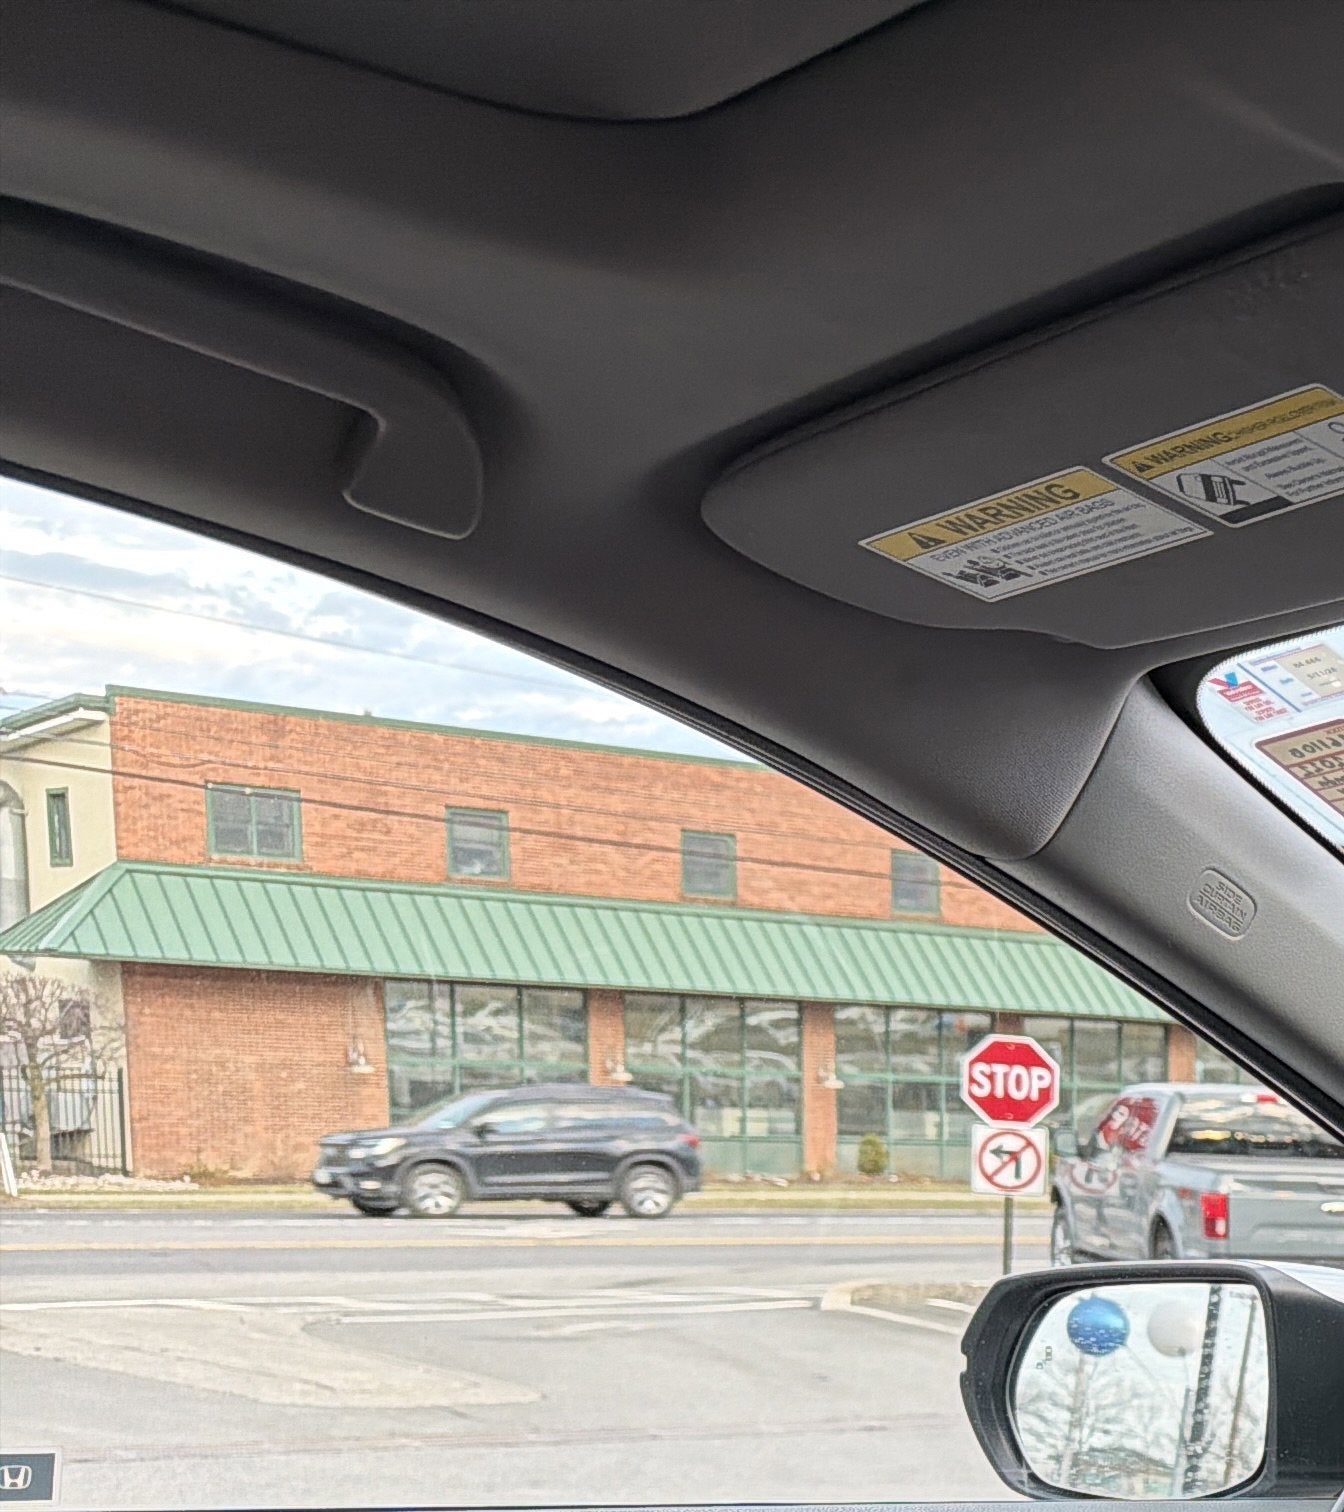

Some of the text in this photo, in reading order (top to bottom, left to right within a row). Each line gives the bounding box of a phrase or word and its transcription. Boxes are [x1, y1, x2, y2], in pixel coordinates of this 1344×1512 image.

[938, 483, 1081, 536] WARNING
[1202, 883, 1247, 920] CURTAIN
[1216, 881, 1243, 905] SIDE
[1196, 895, 1240, 932] AIRBAG
[969, 1063, 1051, 1101] STOP
